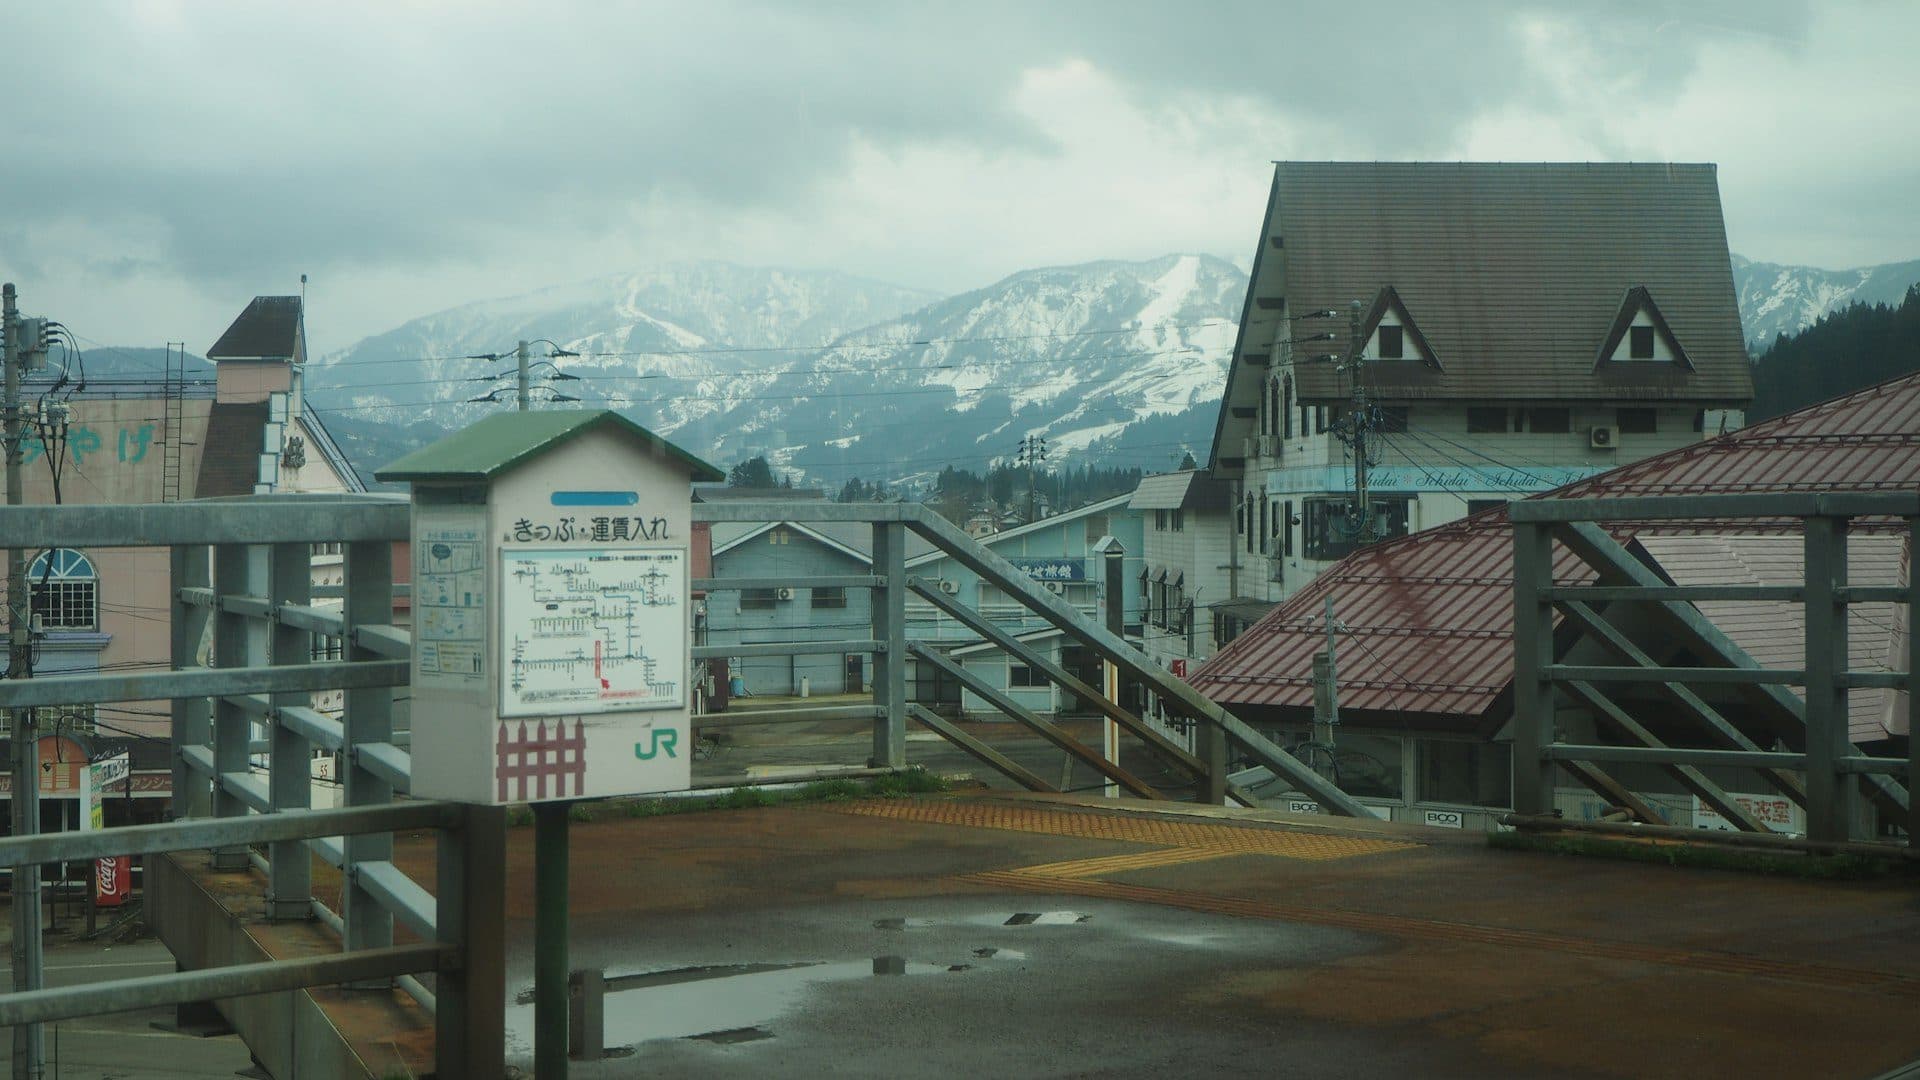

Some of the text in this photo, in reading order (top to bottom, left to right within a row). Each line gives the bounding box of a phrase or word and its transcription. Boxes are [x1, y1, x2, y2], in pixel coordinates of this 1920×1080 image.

[514, 516, 669, 543] きっぷ・運賃入れ
[634, 727, 678, 761] JR
